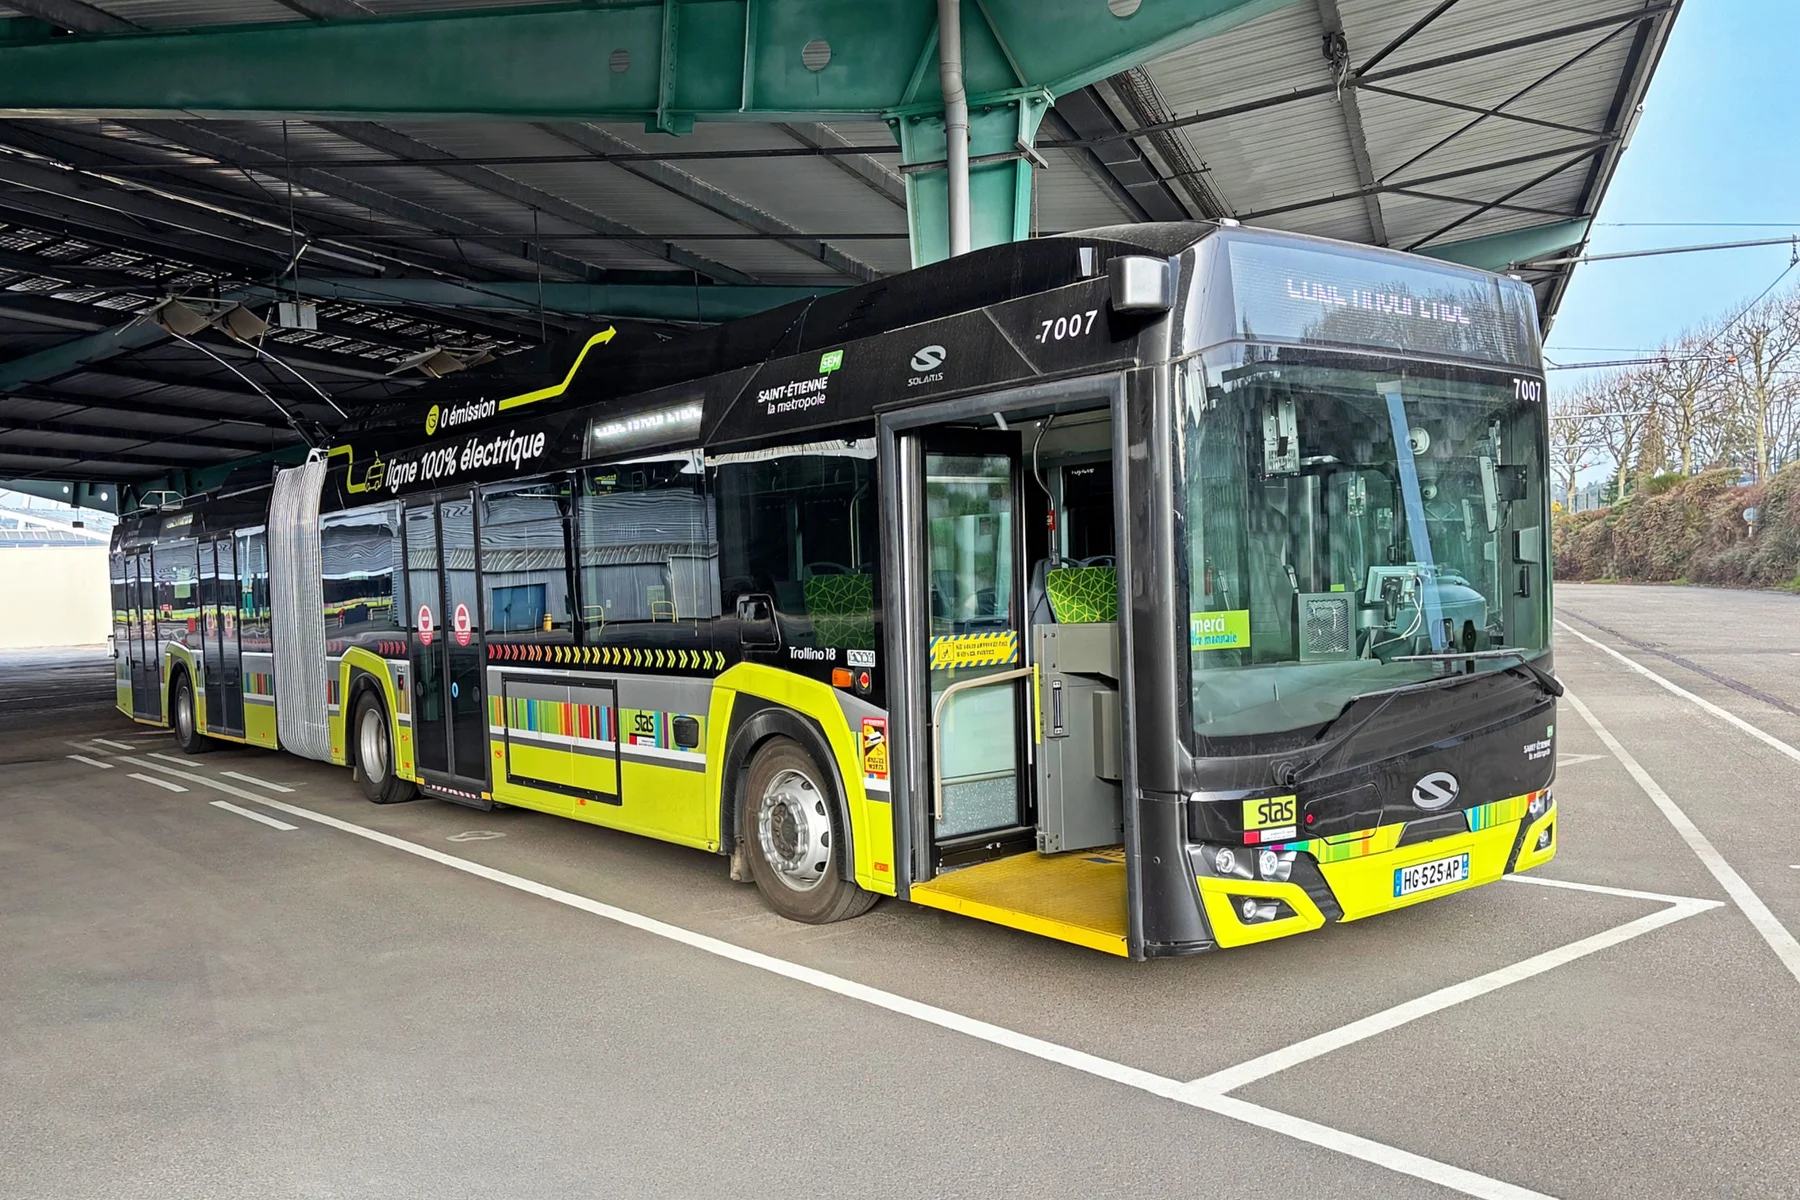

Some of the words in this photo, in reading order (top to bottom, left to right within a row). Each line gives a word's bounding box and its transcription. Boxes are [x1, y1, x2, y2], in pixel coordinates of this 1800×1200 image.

[1041, 309, 1098, 343] 7007
[757, 377, 829, 403] SAINT-ÉTIENNE
[1513, 378, 1541, 402] 7007
[441, 407, 449, 429] 0
[449, 397, 495, 426] émission
[767, 403, 776, 415] la
[385, 458, 418, 493] ligne
[420, 445, 459, 480] 100%
[460, 429, 545, 470] électrique
[1191, 613, 1225, 632] merci
[825, 648, 836, 660] 18
[634, 709, 654, 732] stas
[1258, 797, 1294, 825] stas
